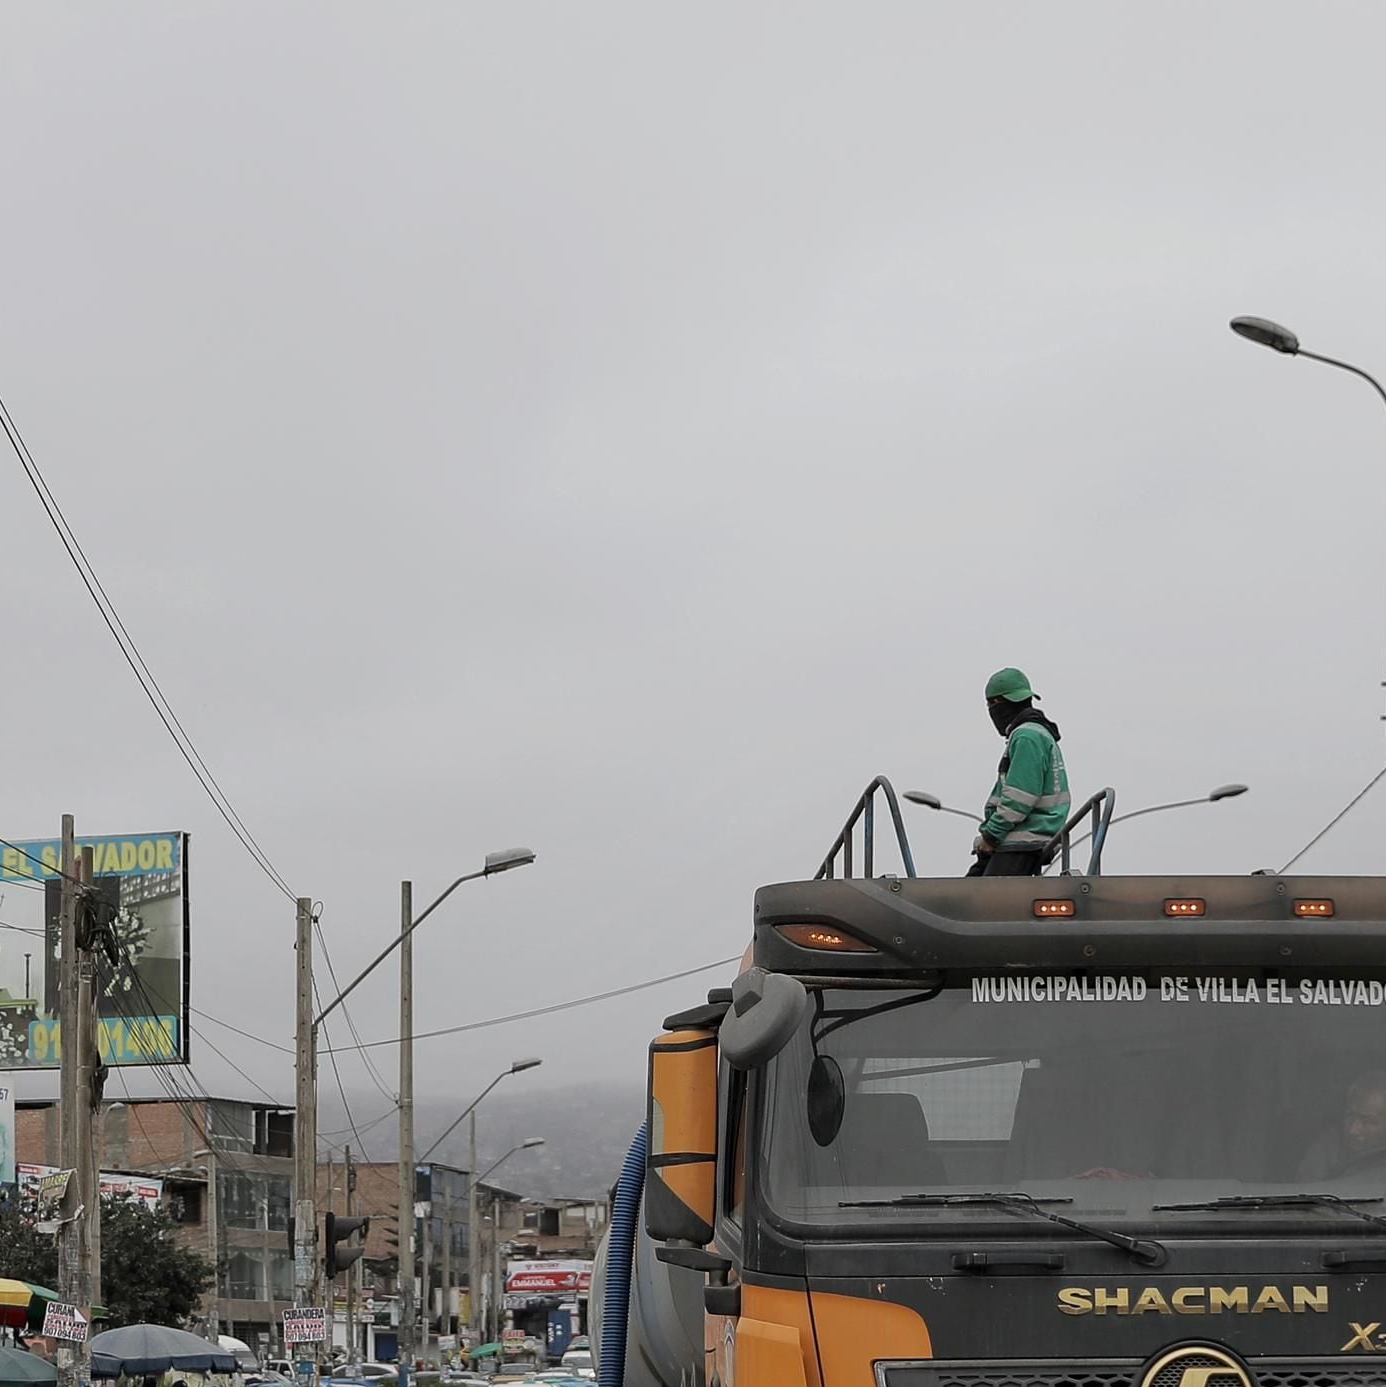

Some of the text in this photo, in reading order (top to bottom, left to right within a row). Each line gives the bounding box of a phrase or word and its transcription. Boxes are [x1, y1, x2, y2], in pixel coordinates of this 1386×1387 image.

[3, 847, 33, 877] EL
[41, 840, 173, 875] SVADOR
[972, 976, 1146, 1002] MUNICIPALIDAD
[1161, 977, 1190, 1001] DE
[1196, 977, 1260, 1003] VILLA
[1266, 978, 1293, 1003] EL
[284, 1309, 324, 1320] CURANDERA
[1057, 1286, 1329, 1315] SHACMAN
